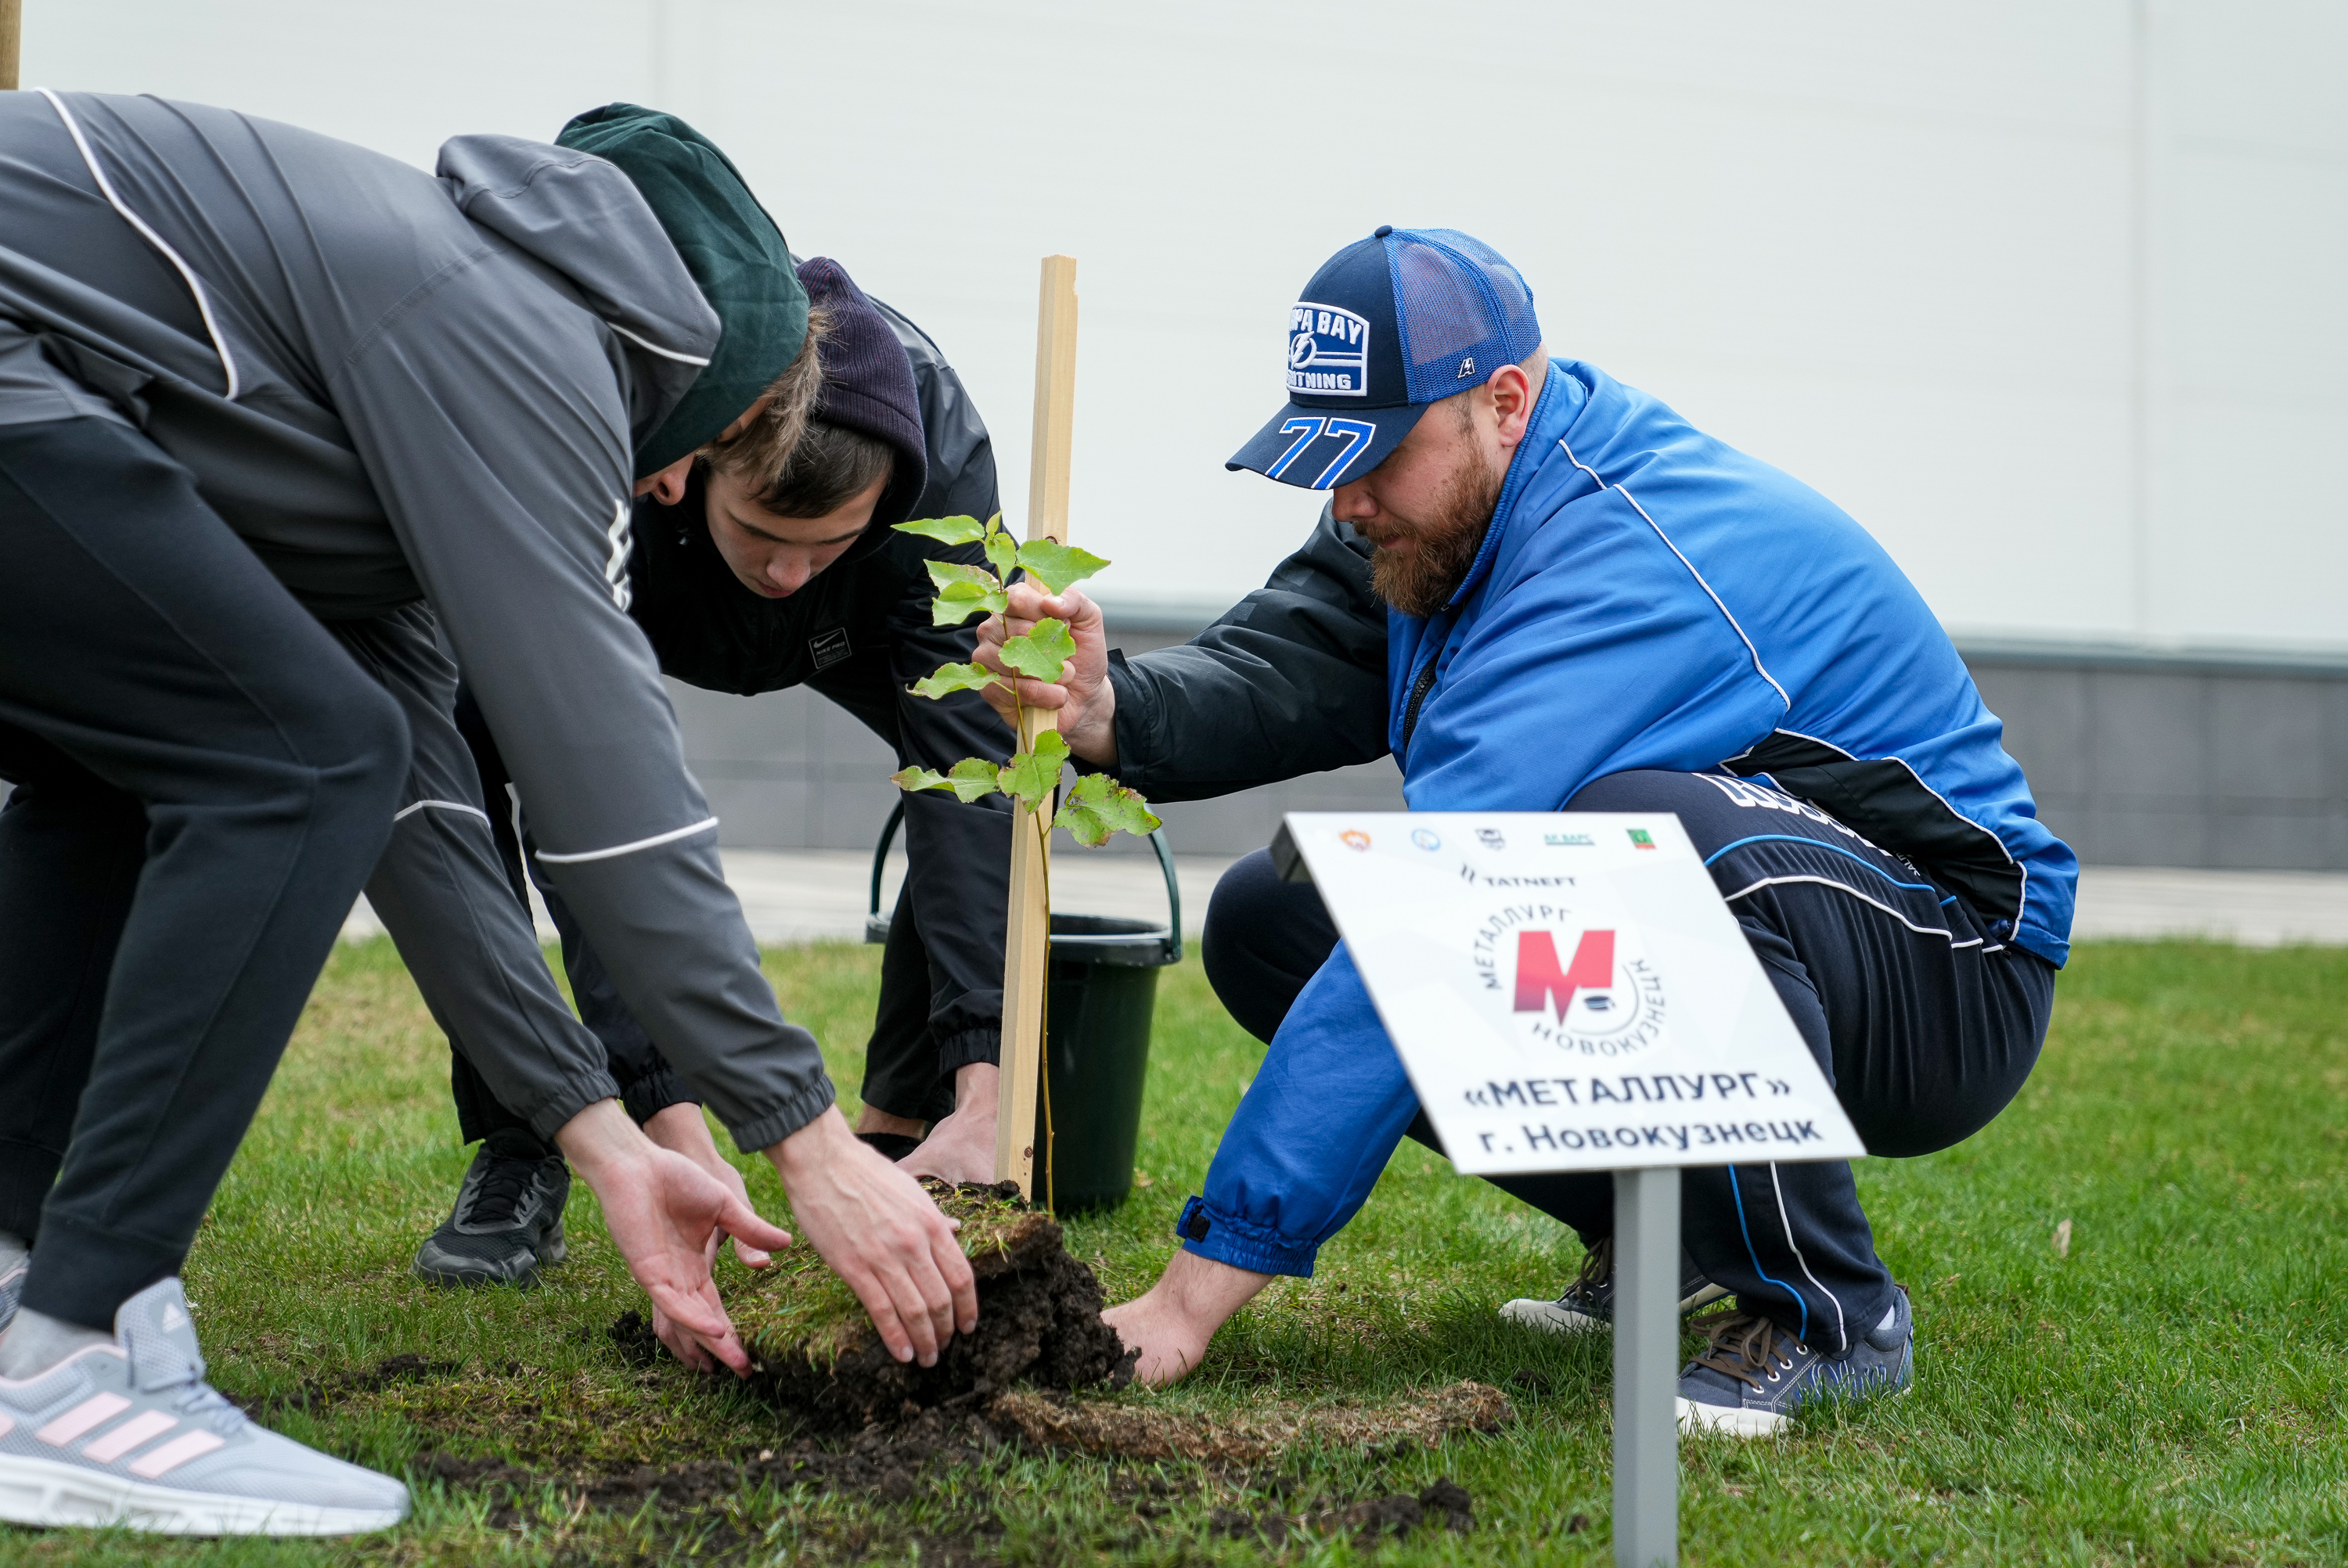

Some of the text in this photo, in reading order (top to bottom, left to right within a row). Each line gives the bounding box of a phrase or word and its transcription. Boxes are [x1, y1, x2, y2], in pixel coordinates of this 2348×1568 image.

[1316, 311, 1362, 345] BAY
[1265, 416, 1377, 491] 77
[816, 641, 846, 656] NIKE PRO
[1482, 876, 1576, 888] TATNEFT
[1473, 903, 1572, 991] МЕТАЛЛУРГ
[1532, 958, 1668, 1057] НОВОКУЗНЕЦК
[1464, 1072, 1791, 1107] «МЕТАЛЛУРГ»
[1479, 1118, 1823, 1153] г. Новокузнецк
